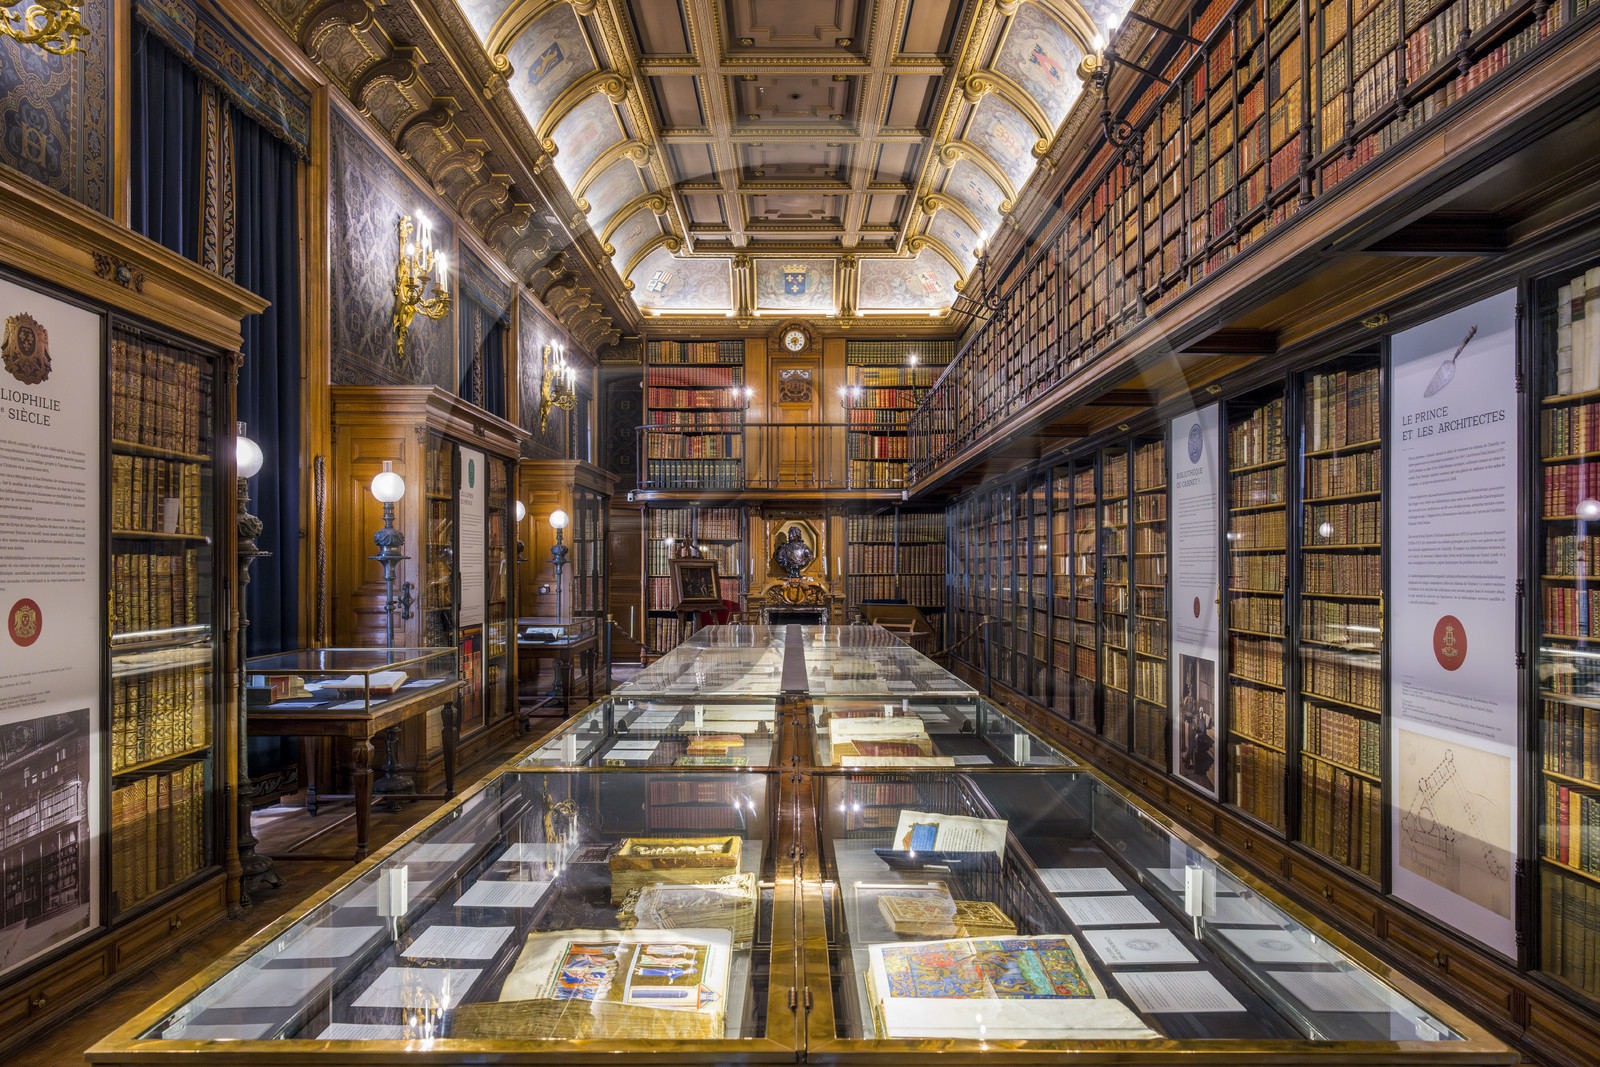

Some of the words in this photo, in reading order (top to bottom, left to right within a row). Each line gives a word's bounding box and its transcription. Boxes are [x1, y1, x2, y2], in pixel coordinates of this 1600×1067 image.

[8, 408, 51, 426] SIÈCLE
[1402, 414, 1412, 426] LE
[1415, 406, 1449, 424] PRINCE
[1402, 430, 1413, 441] ET
[1417, 425, 1433, 438] LES
[1438, 410, 1505, 434] ARCHITECTES
